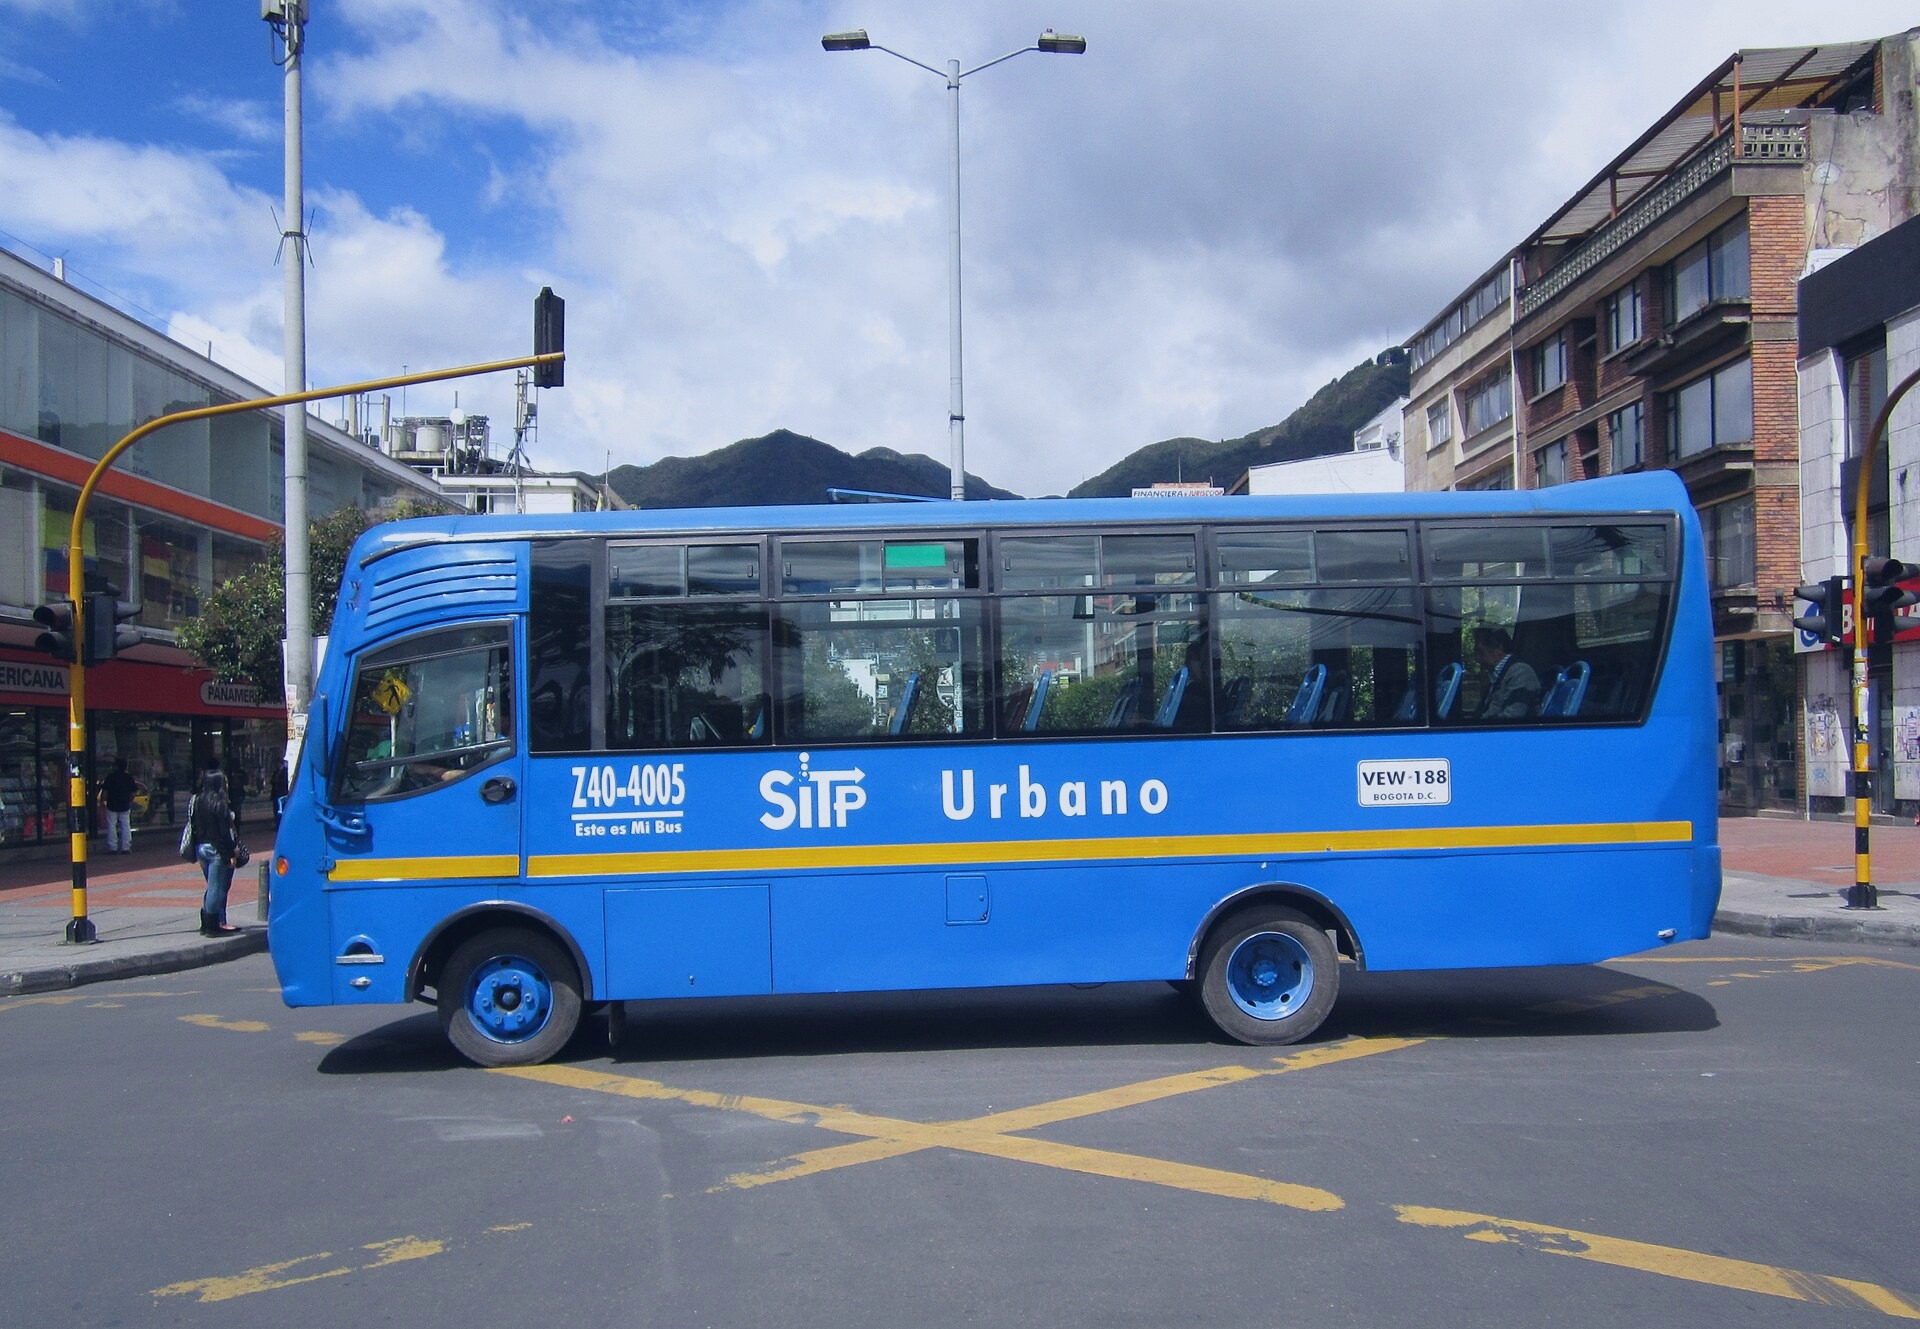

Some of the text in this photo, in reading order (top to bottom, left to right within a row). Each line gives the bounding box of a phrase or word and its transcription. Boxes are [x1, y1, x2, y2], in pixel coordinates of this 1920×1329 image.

[1133, 490, 1183, 498] FINANCIERA
[571, 763, 686, 808] Z40-4005
[941, 764, 1169, 821] Urbano
[1373, 791, 1437, 801] BOGOTA D.C.
[575, 819, 682, 837] Este es Mi Bus
